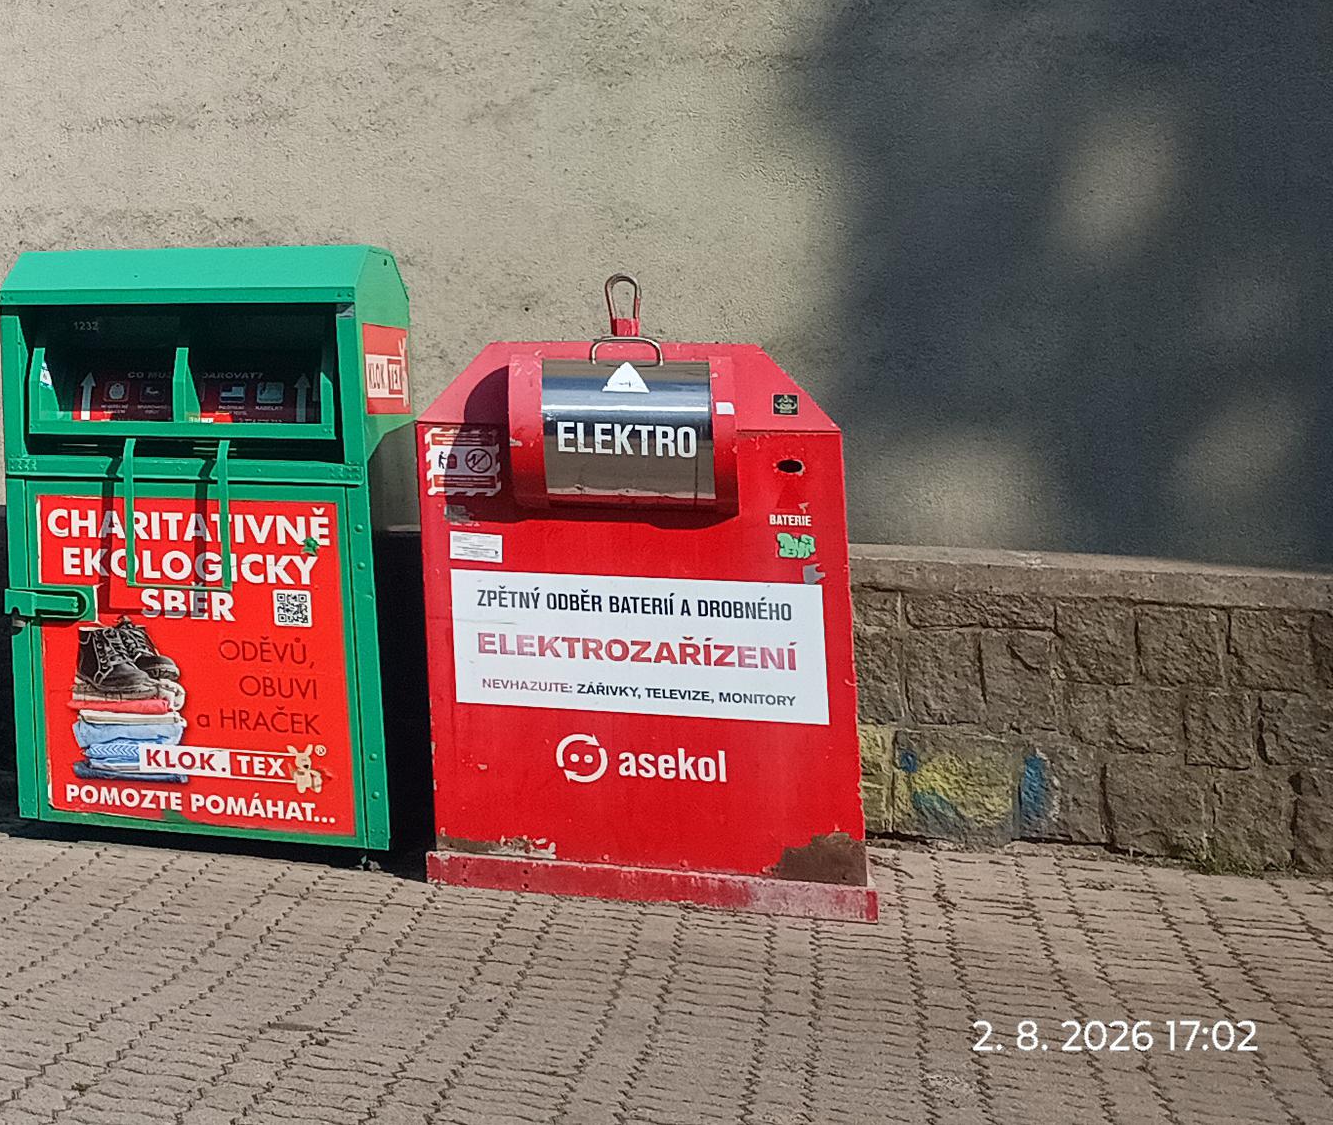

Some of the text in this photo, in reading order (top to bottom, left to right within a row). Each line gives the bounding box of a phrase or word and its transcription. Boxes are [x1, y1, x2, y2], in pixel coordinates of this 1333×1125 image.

[557, 421, 697, 458] ELEKTRO
[769, 514, 812, 526] BATERIE
[141, 581, 235, 622] SBĚR
[477, 585, 792, 621] ZPĚTNÝ ODBĚR BATERIÍ A DROBNÉHO
[219, 636, 314, 669] ODĚVŮ,
[477, 632, 797, 671] ELEKTROZAŘÍZENÍ
[239, 675, 318, 700] OBUVI
[482, 678, 797, 707] NEVHAZUJTE: ZÁŘIVKY, TELEVIZE, MONITORY
[196, 705, 321, 735] a HRAČEK
[237, 755, 285, 777] TEX
[618, 747, 727, 783] asekol
[66, 784, 336, 824] POMOZTE POMÁHAT...
